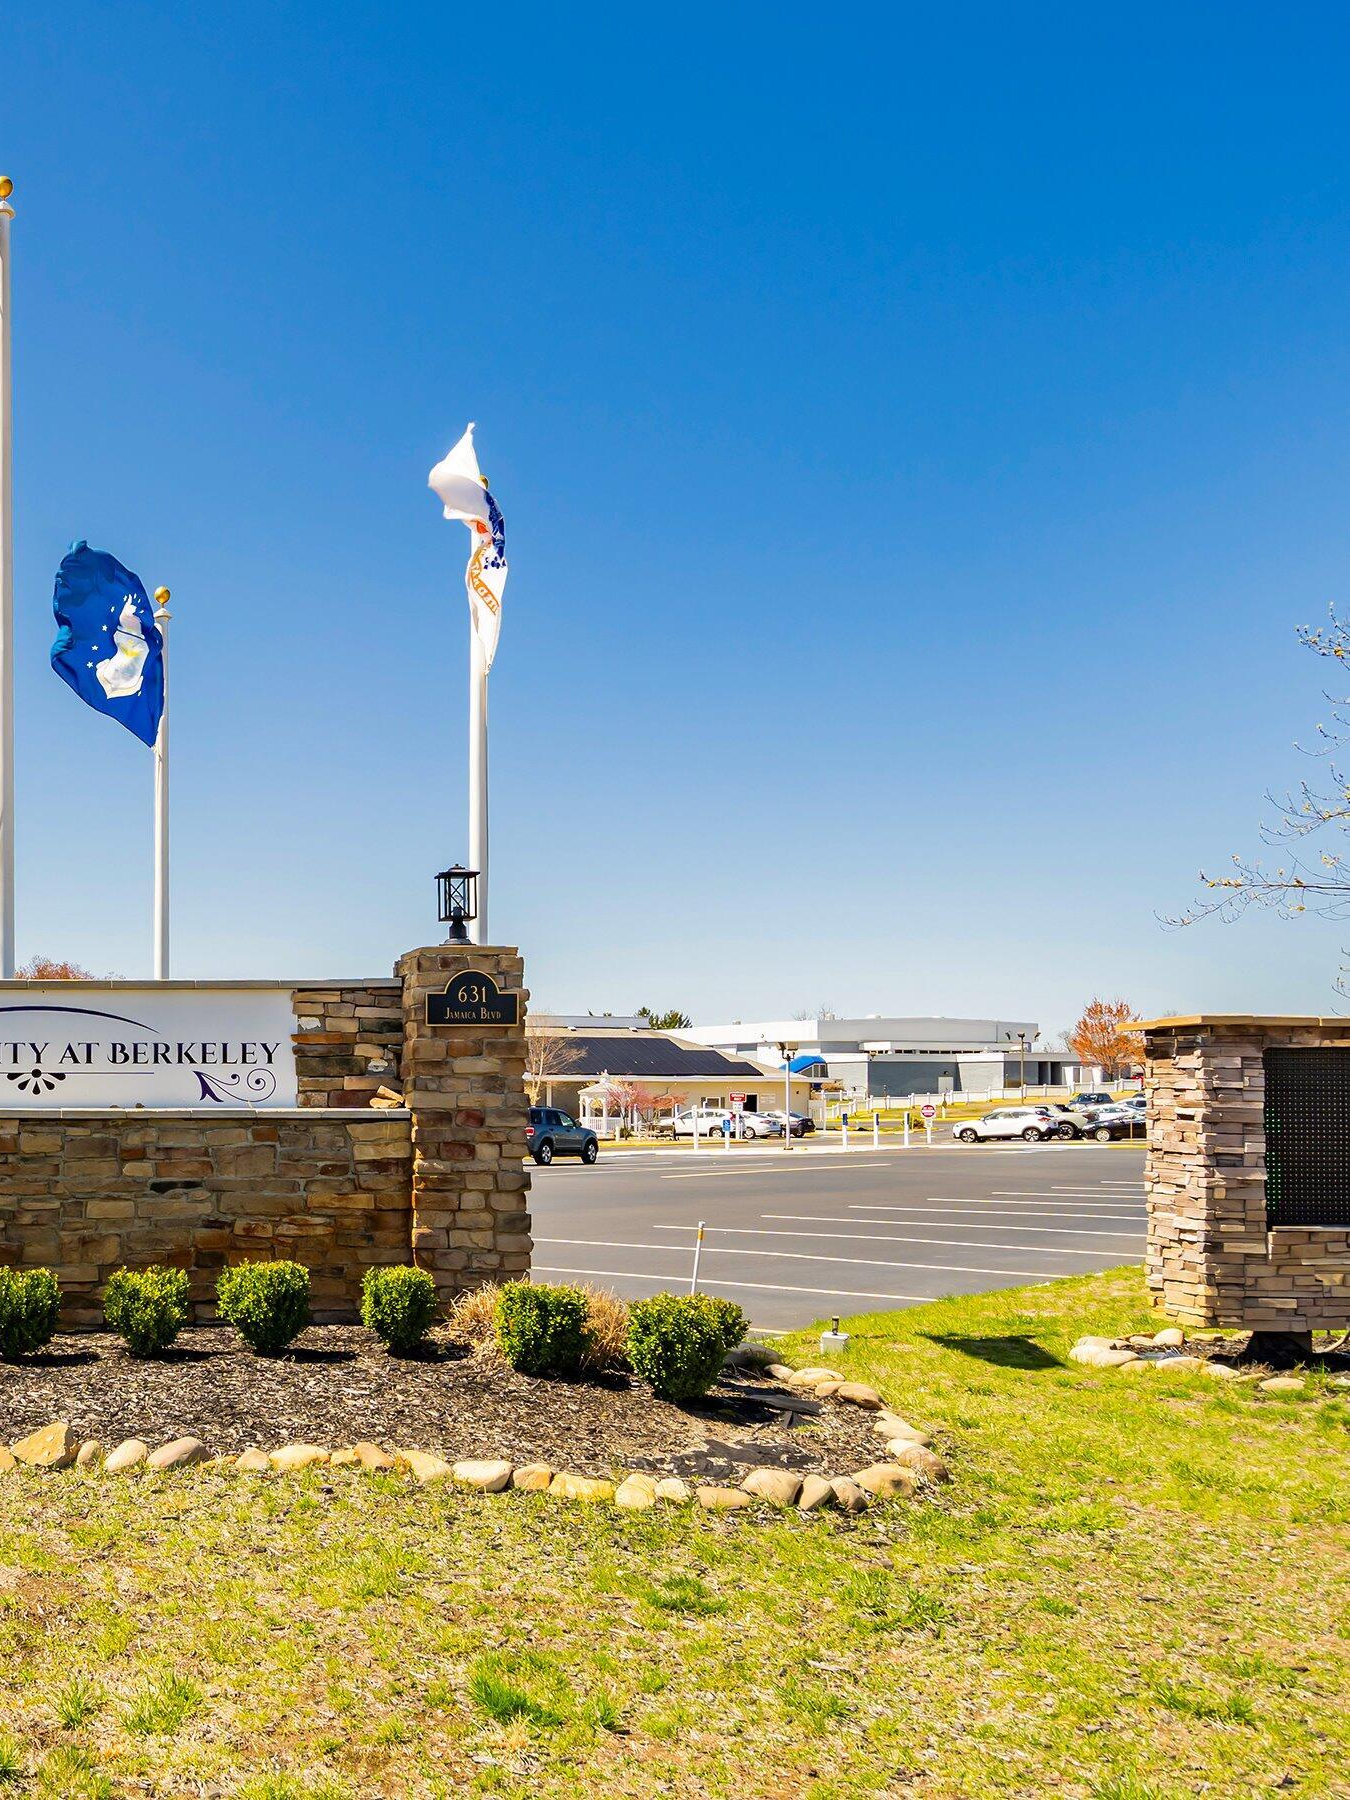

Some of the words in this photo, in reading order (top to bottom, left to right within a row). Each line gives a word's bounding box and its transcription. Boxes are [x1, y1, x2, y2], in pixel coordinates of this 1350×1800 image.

[458, 985, 487, 1003] 631
[58, 1041, 100, 1065] AT
[106, 1041, 282, 1065] BERKELEY
